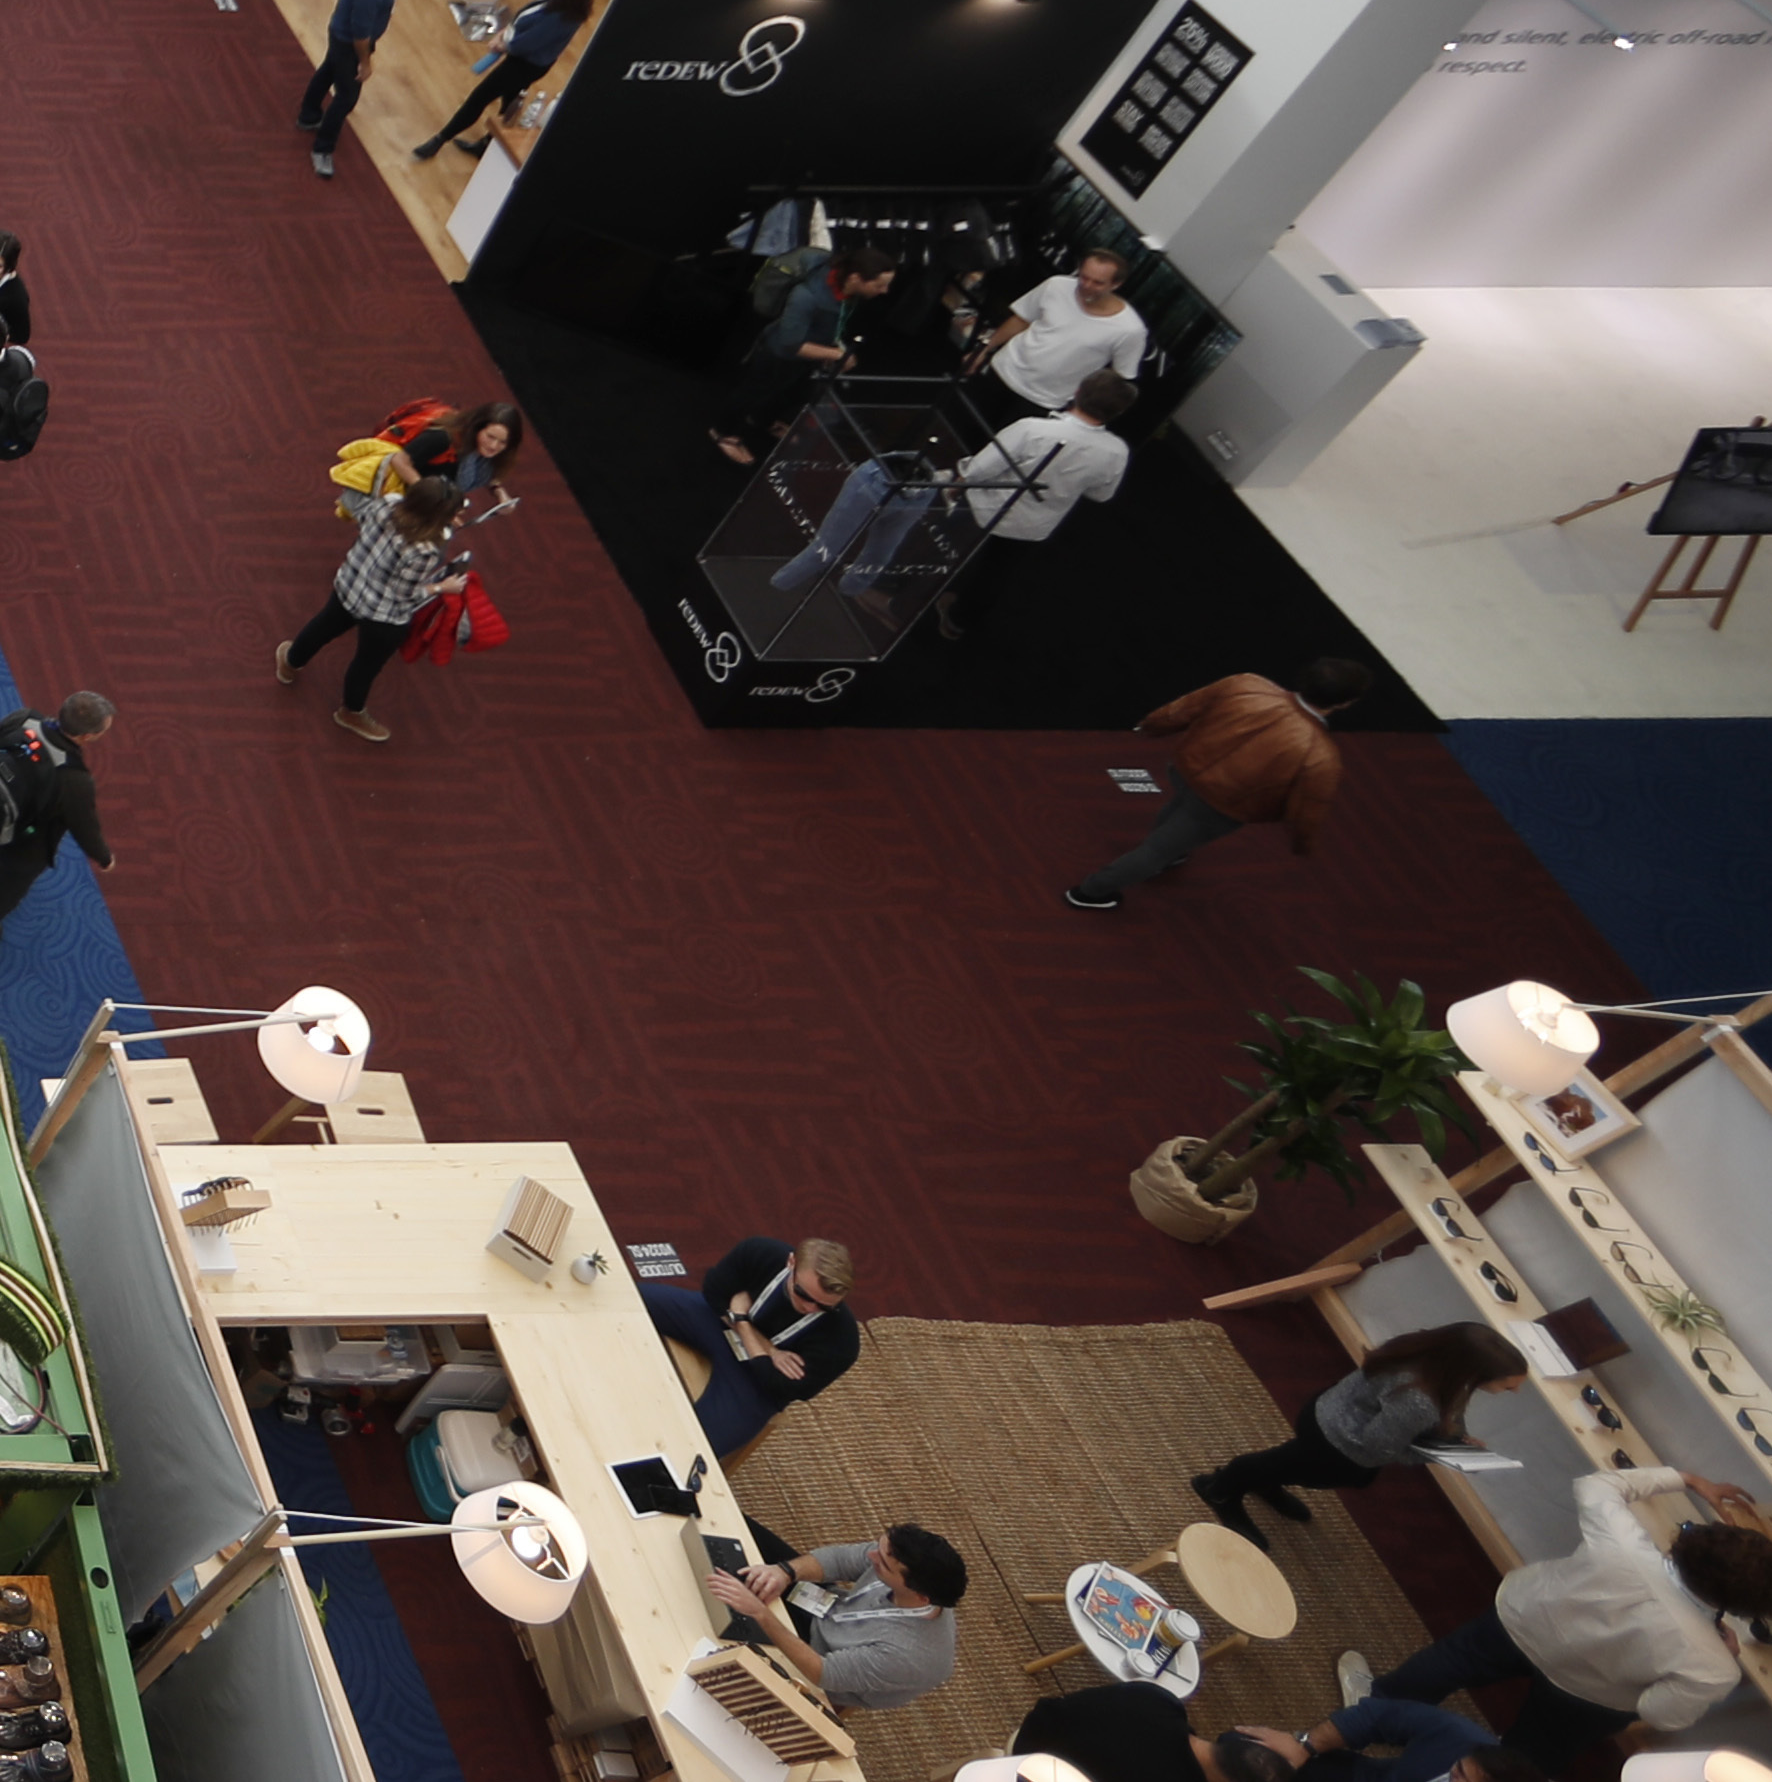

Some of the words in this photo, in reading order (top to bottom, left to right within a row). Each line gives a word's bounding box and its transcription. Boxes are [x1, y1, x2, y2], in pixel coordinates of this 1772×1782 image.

[1499, 29, 1570, 48] silent,
[1667, 29, 1767, 46] off-road
[1437, 59, 1527, 76] respect.
[635, 1262, 687, 1278] OUTDOOR
